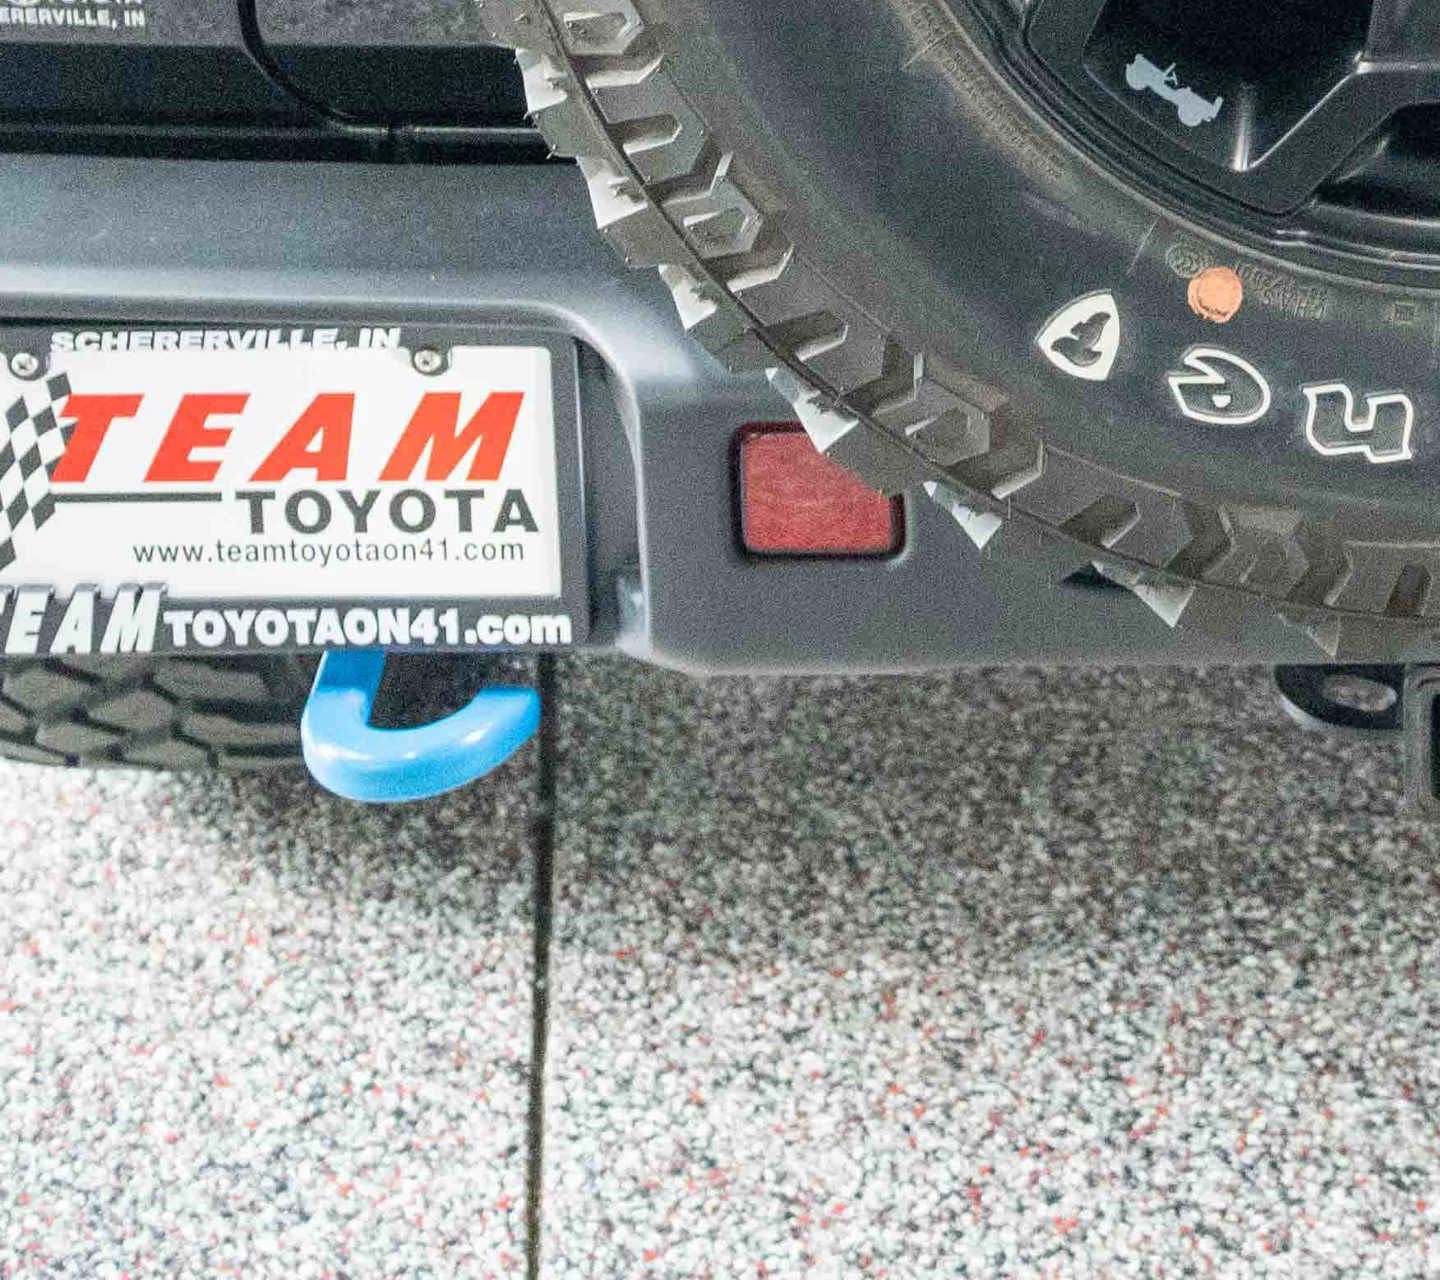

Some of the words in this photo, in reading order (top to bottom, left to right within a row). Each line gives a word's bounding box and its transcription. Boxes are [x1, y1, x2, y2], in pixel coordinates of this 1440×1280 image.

[124, 10, 146, 27] IN
[361, 329, 401, 349] IN
[50, 392, 525, 483] TEAM
[235, 489, 539, 535] TOYOTA
[132, 538, 525, 566] www.teamtoyotaon41.com
